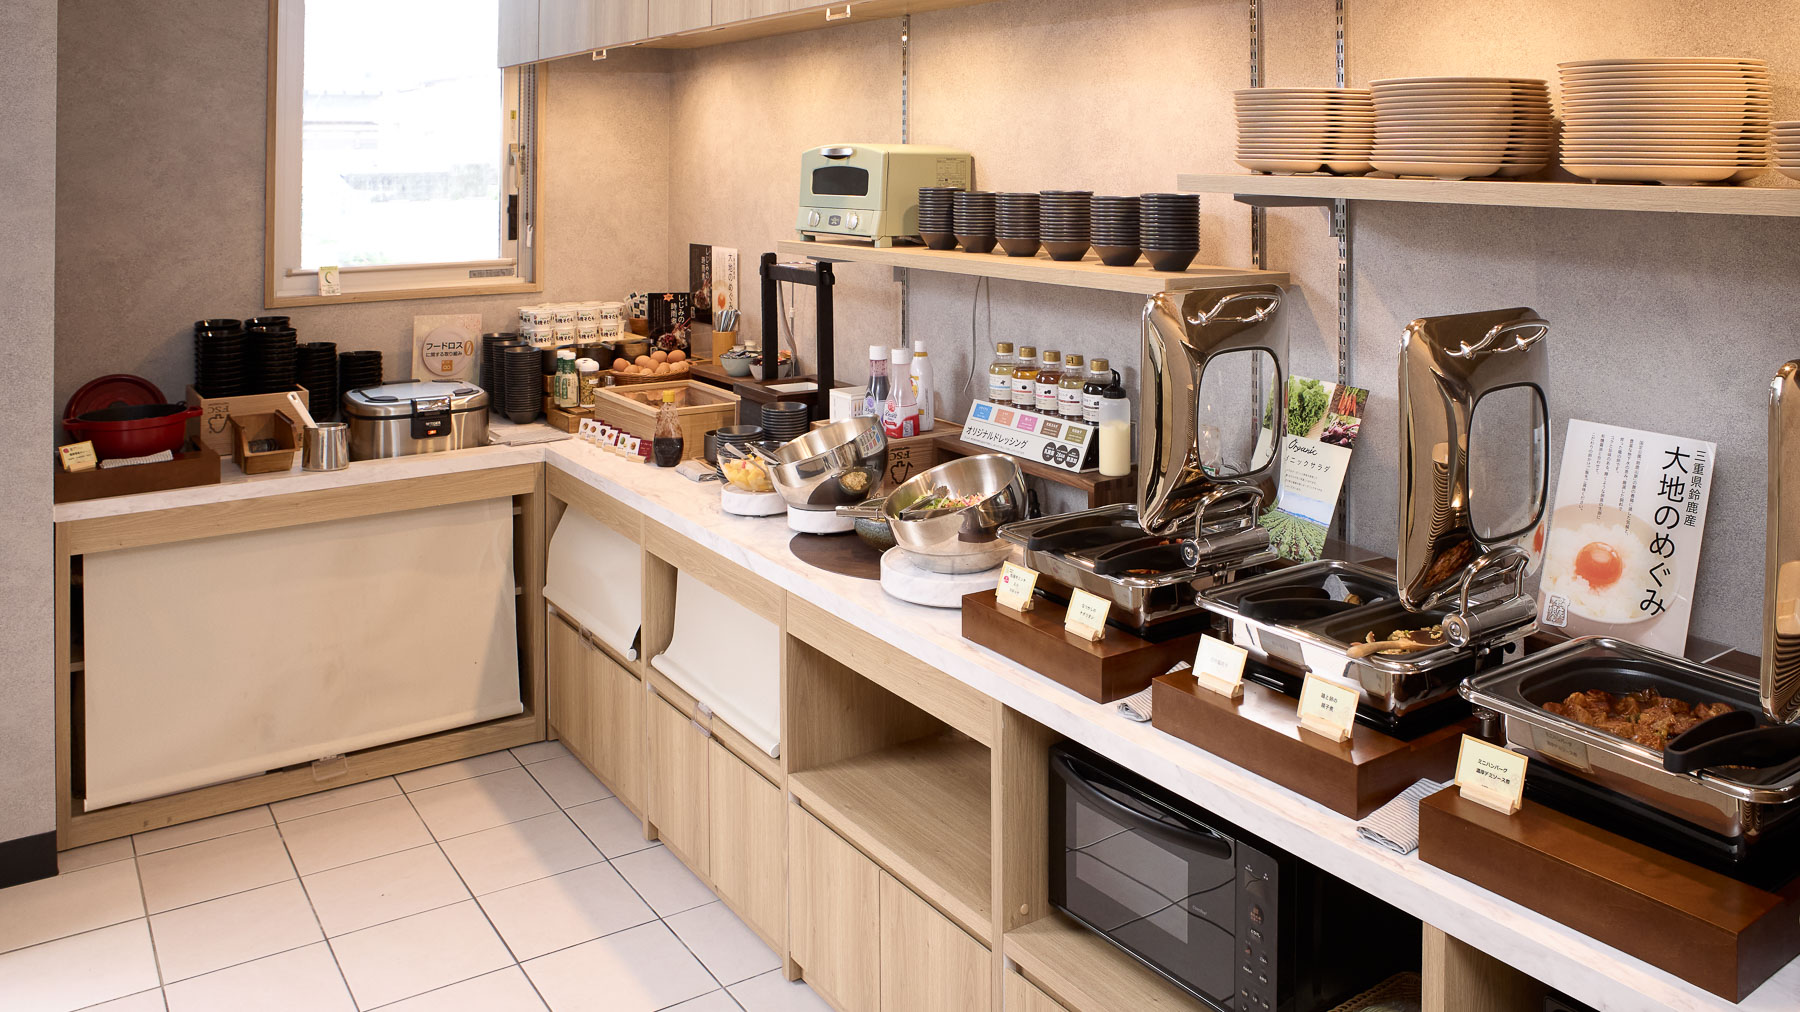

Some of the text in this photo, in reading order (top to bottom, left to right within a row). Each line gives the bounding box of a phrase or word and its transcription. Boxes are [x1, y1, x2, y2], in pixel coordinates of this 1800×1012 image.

[426, 342, 463, 350] フードロス
[207, 405, 229, 413] FSC
[966, 425, 1029, 449] オリジナルドレッシング
[889, 450, 910, 461] FSC
[1288, 438, 1318, 456] Organic
[1683, 450, 1707, 528] 三重県鈴鹿産
[1639, 446, 1691, 616] 大地のめぐみ
[1478, 758, 1508, 774] ミニハンバーグ
